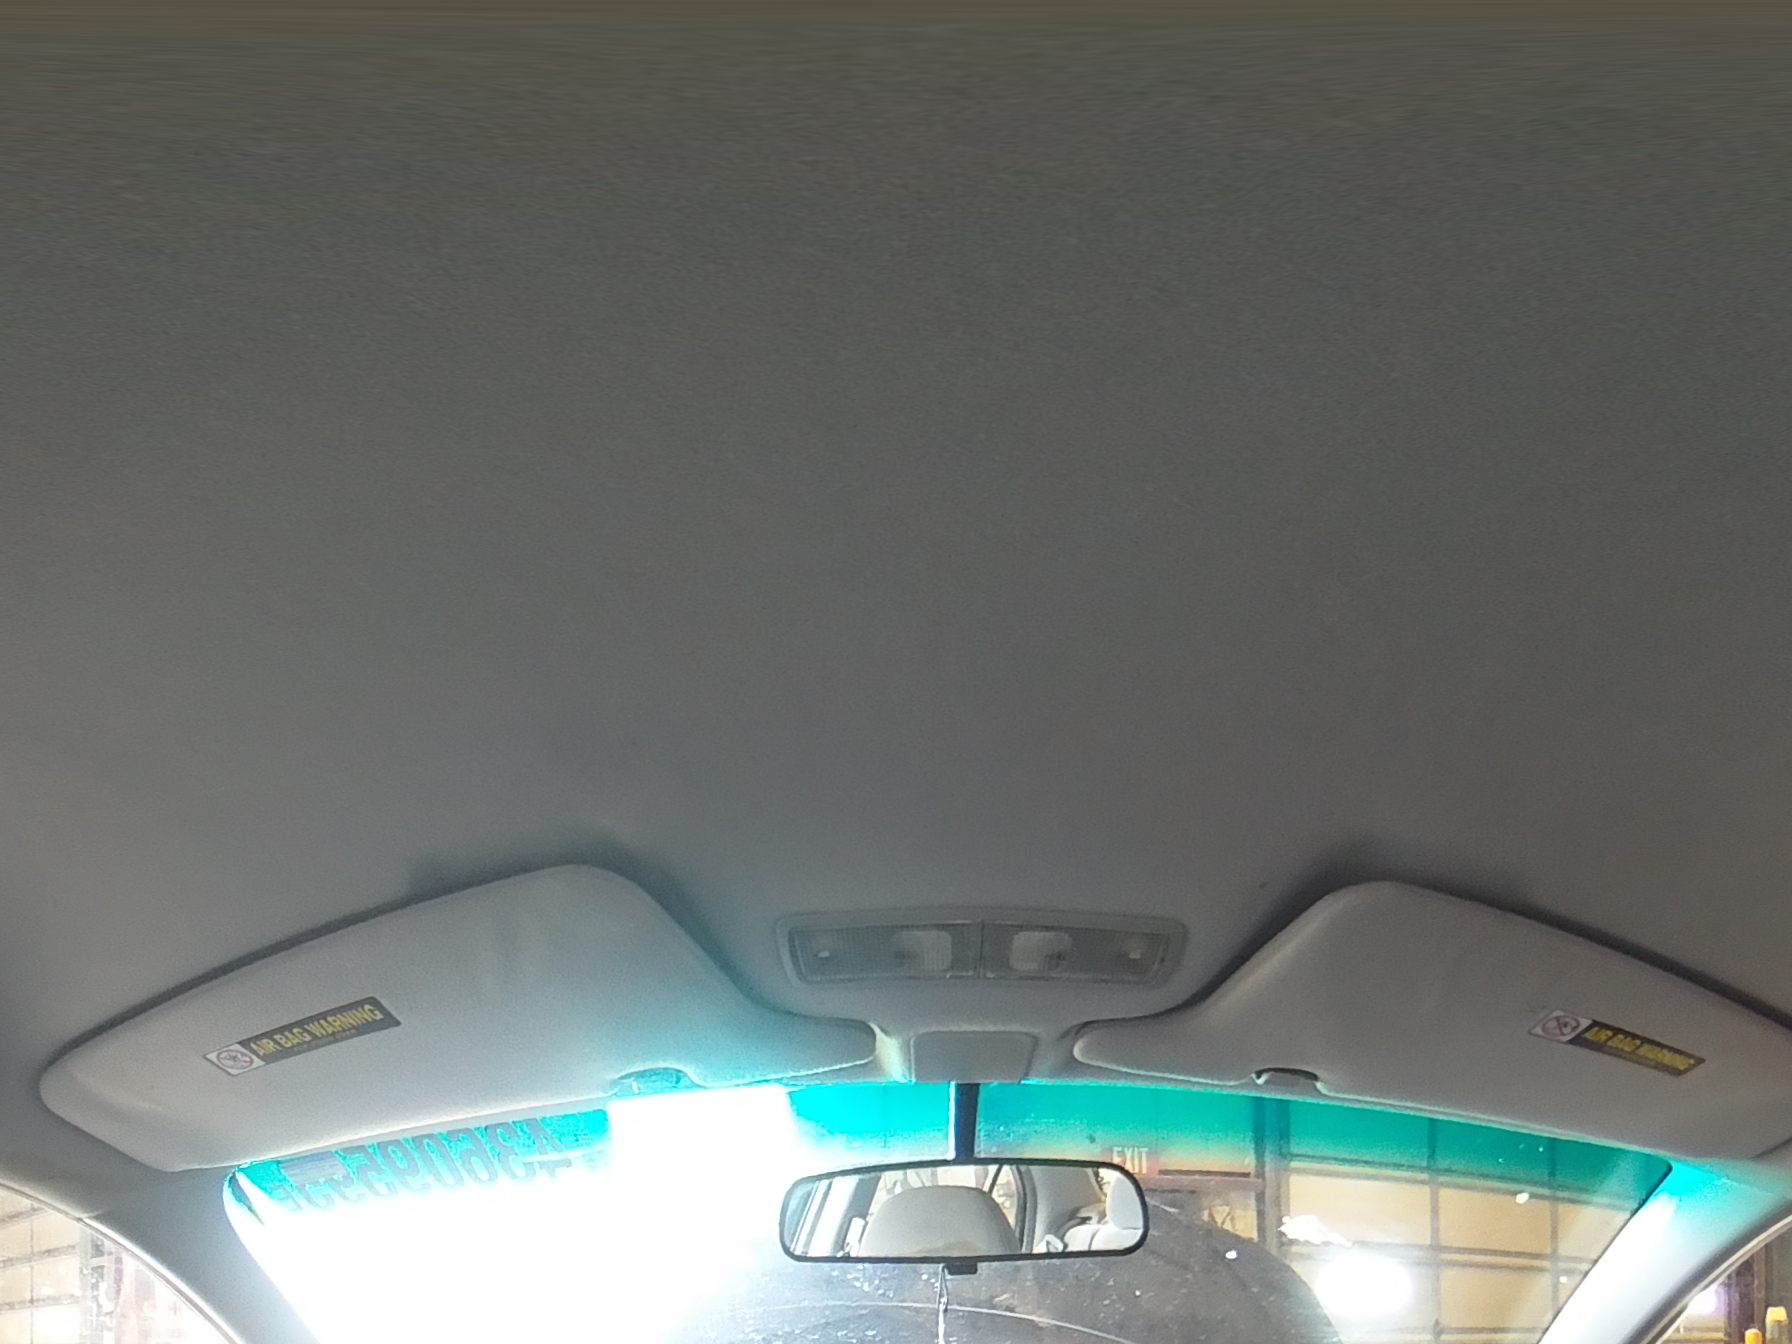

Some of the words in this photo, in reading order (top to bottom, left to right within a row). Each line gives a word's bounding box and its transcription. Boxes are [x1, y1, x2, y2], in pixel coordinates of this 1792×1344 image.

[250, 1037, 281, 1057] AIR
[276, 1027, 310, 1049] BAG
[304, 1004, 384, 1038] WARNING
[1112, 1146, 1149, 1174] EXIT
